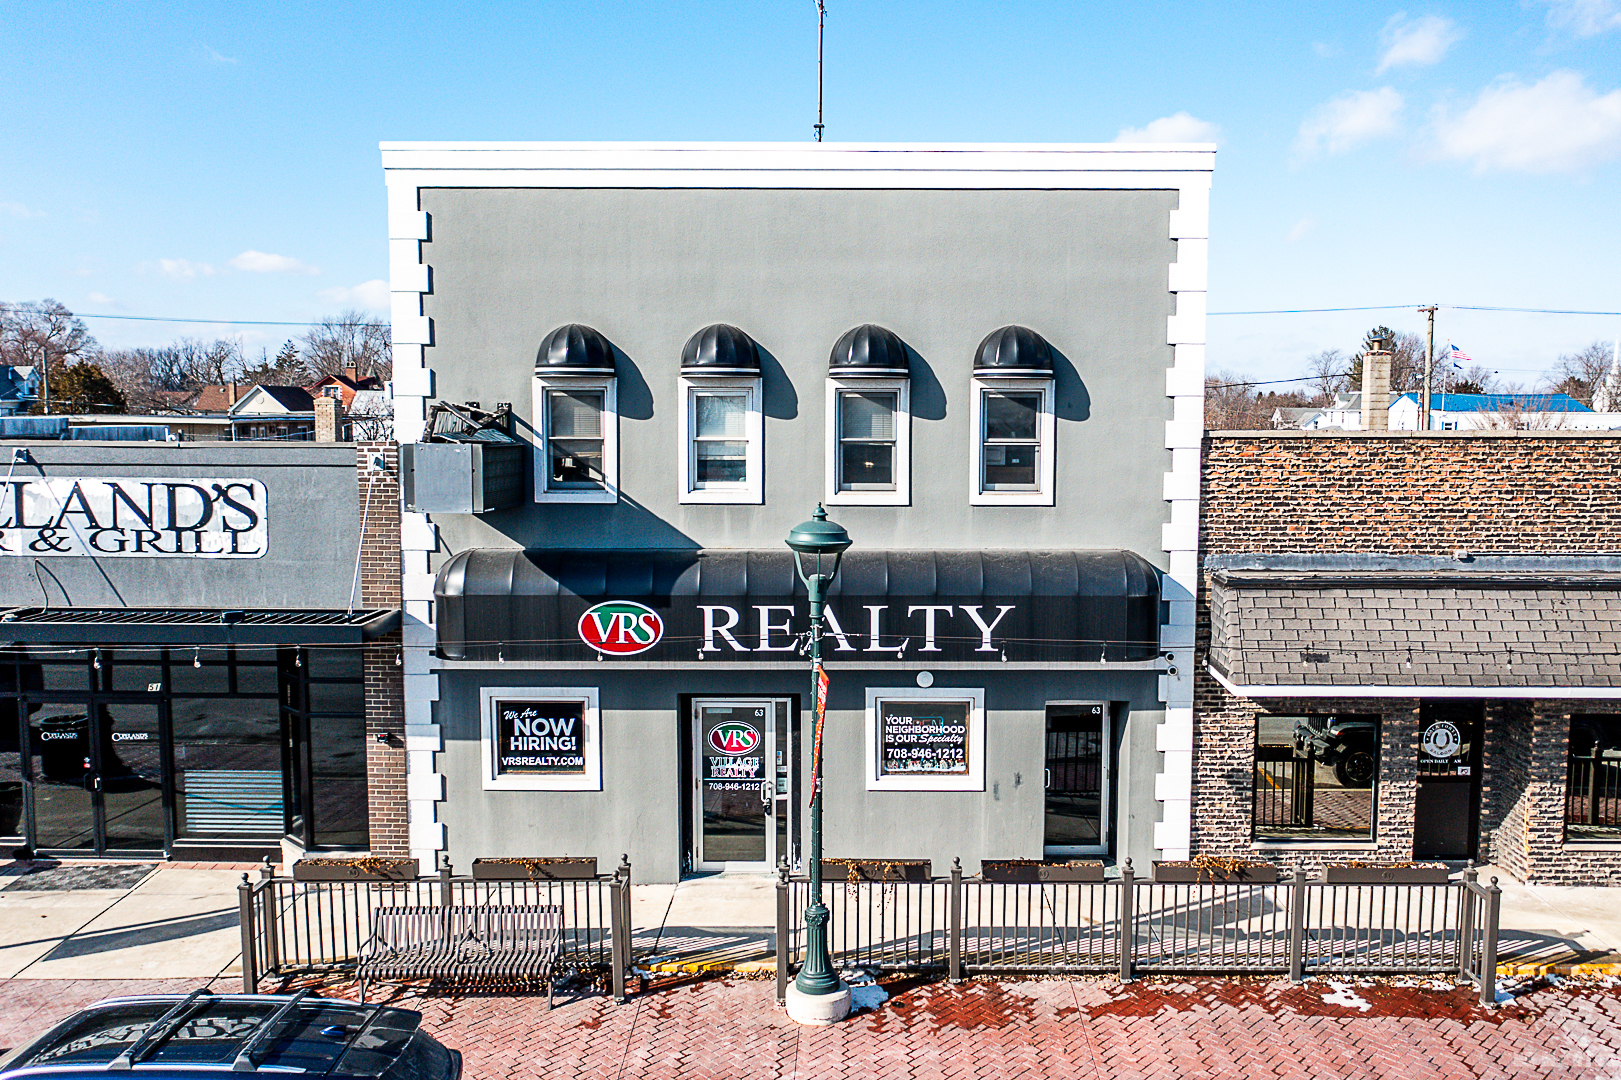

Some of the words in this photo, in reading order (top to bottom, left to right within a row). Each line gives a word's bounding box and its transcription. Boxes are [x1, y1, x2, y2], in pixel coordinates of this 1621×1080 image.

[28, 527, 72, 553] &
[88, 528, 261, 554] GRILL
[590, 611, 656, 645] VRS
[696, 605, 1016, 652] REALTY
[503, 710, 519, 720] We
[520, 707, 537, 718] Are
[754, 708, 764, 717] 63
[1091, 706, 1101, 715] 63
[885, 716, 913, 725] YOUR
[514, 718, 575, 736] NOW
[885, 725, 966, 734] NEIGHBORHOOD
[510, 736, 577, 751] HIRING!
[716, 729, 754, 747] VRS
[885, 734, 895, 743] IS
[896, 734, 918, 743] OUR
[918, 733, 963, 744] Specialty
[886, 748, 964, 759] 708-946-1212
[501, 756, 584, 766] VRSREALTY.COM
[709, 756, 760, 767] VILLAGE
[710, 766, 759, 778] REALTY
[708, 782, 760, 791] 708-946-1212
